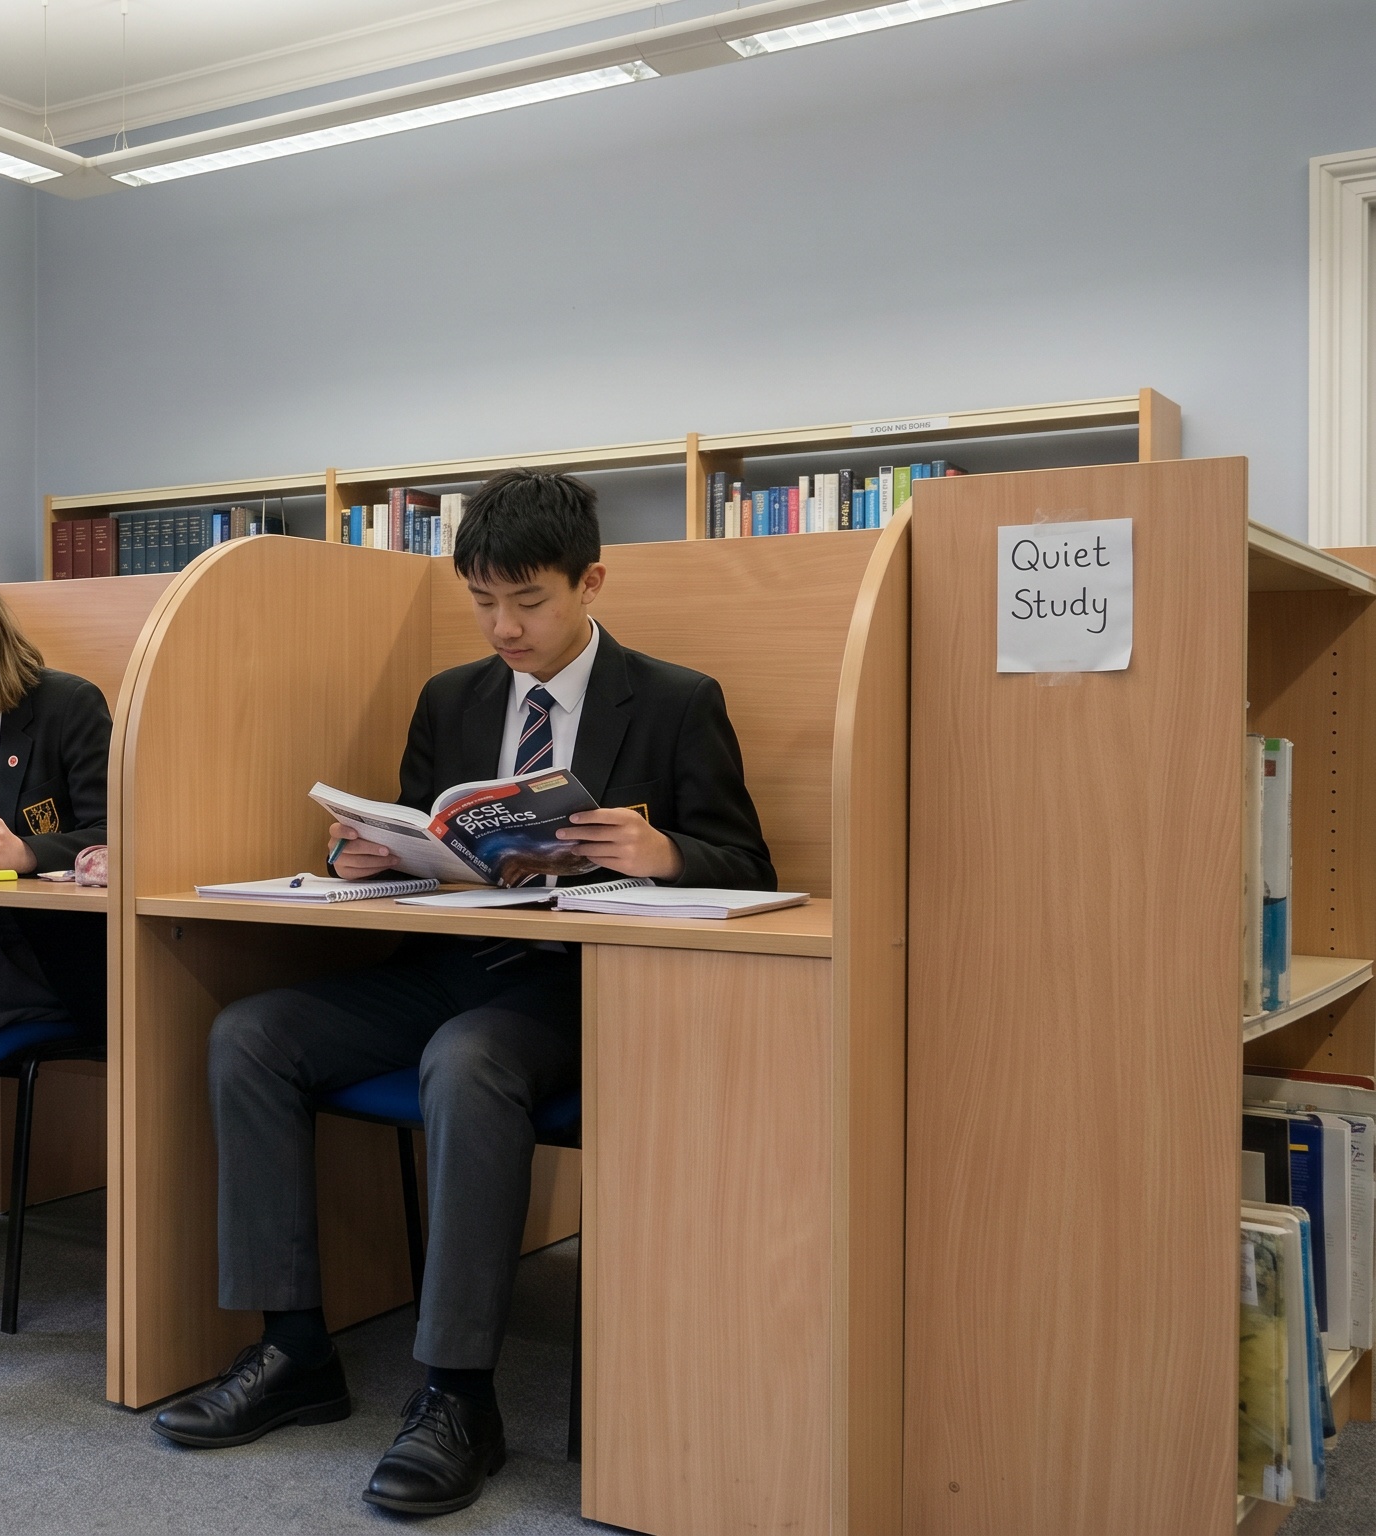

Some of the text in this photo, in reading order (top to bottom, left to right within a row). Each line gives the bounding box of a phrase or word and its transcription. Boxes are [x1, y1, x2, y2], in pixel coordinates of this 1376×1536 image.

[1011, 536, 1110, 571] Quiet
[1011, 587, 1108, 634] Study
[455, 802, 509, 826] GCSE
[464, 811, 537, 835] Physics
